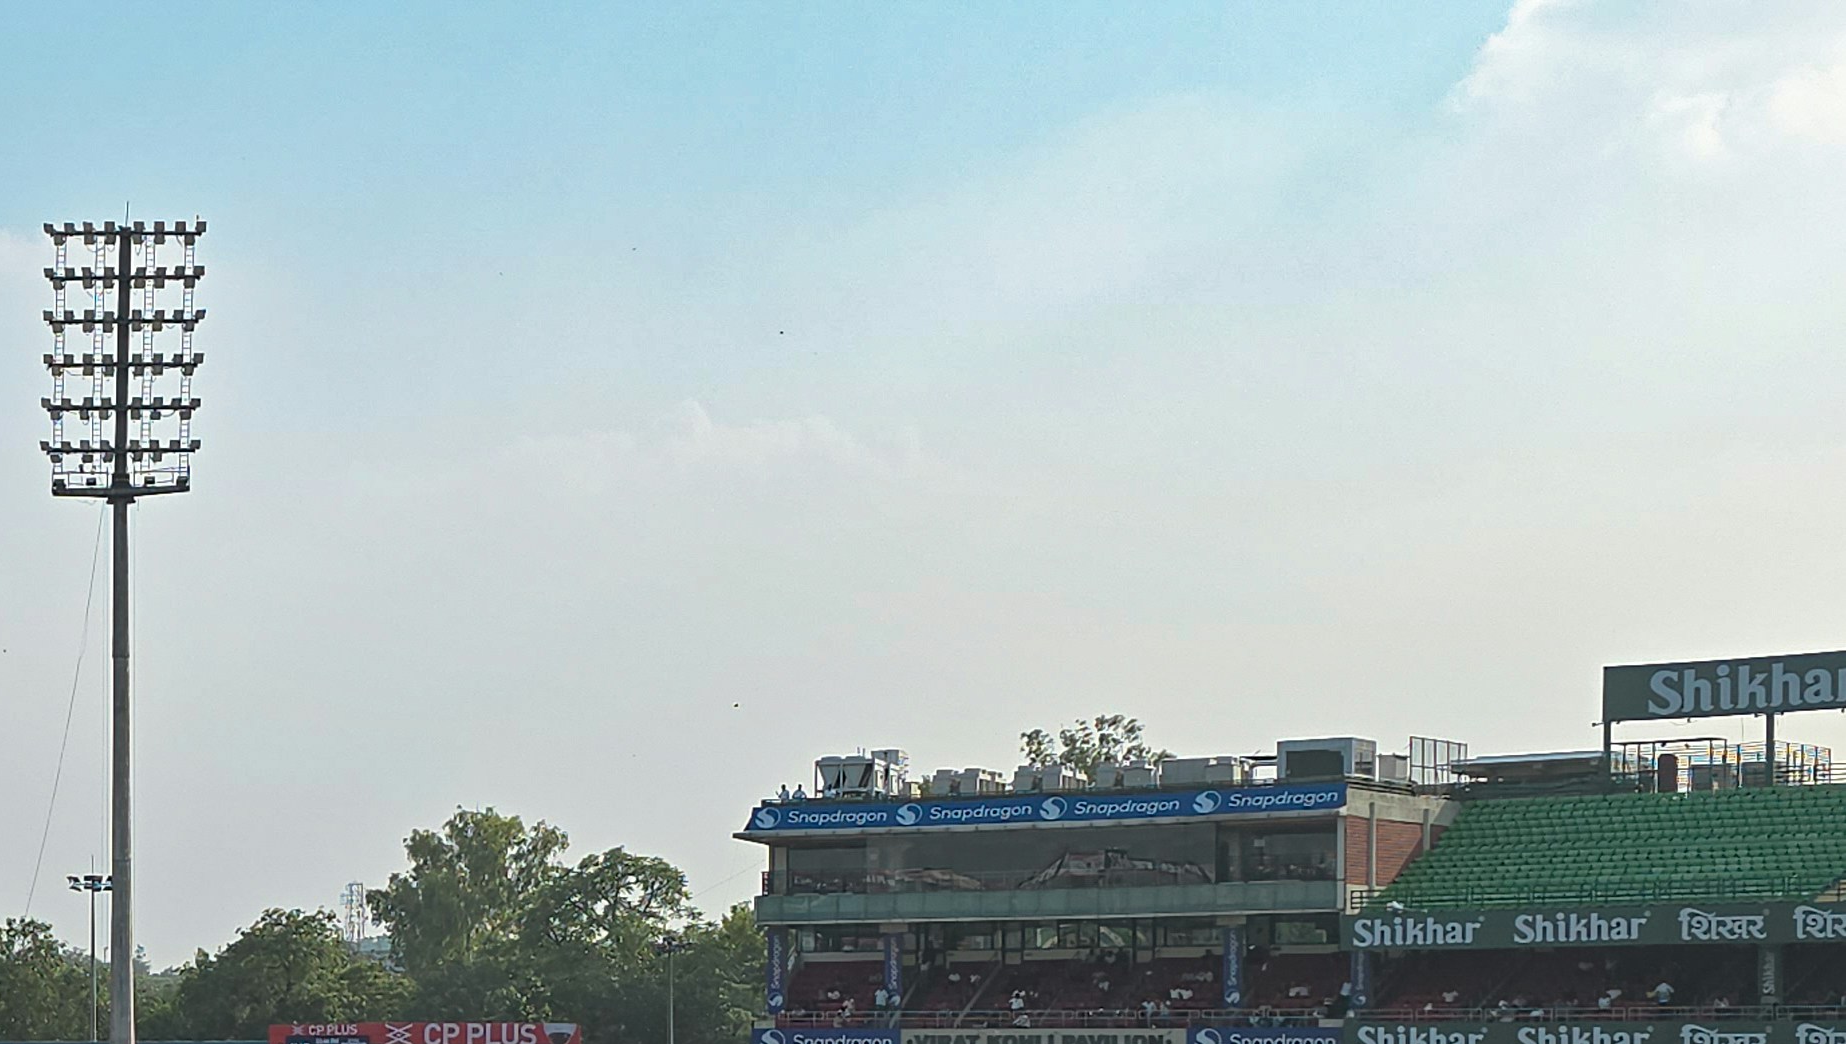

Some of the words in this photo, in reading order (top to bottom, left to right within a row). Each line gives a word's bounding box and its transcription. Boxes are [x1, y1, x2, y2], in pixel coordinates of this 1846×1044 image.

[1074, 797, 1179, 818] Snapdragon
[1227, 790, 1338, 812] Snapdragon
[788, 809, 887, 826] Snapdragon
[929, 804, 1031, 823] Snapdragon
[1353, 916, 1480, 947] Shikhar
[1514, 913, 1646, 944] Shikhar
[1678, 908, 1767, 941] शिखर
[309, 1025, 325, 1035] CP
[327, 1024, 357, 1035] PLUS
